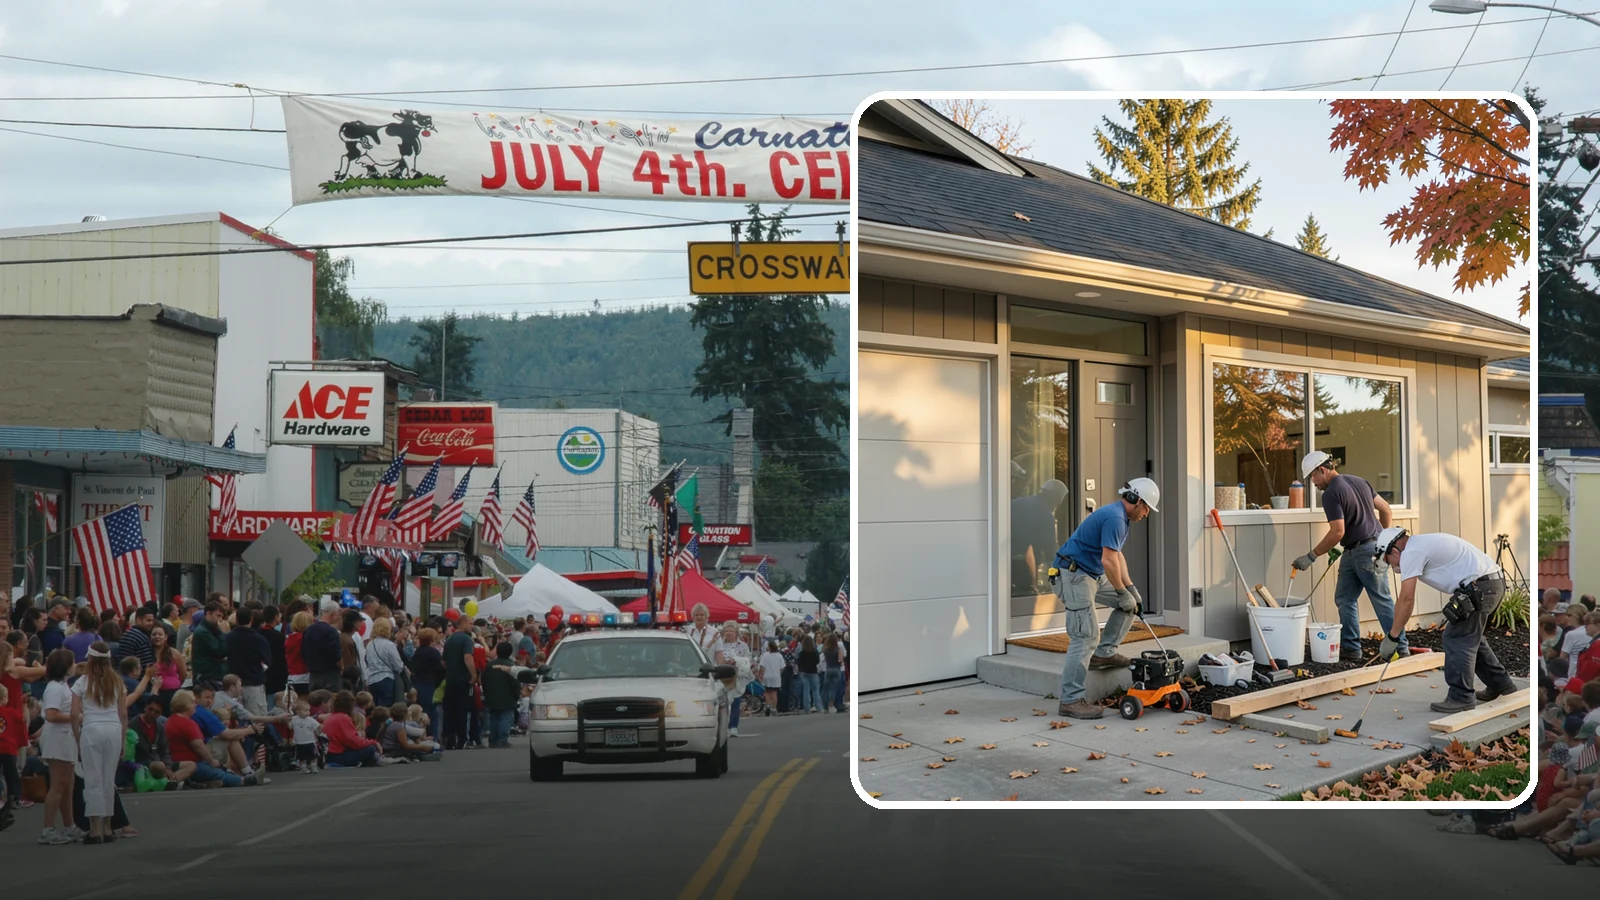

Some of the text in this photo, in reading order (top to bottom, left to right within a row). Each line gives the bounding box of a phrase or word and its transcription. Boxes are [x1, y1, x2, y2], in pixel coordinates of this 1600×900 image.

[481, 140, 605, 192] JULY
[632, 150, 746, 198] 4th.
[697, 254, 850, 280] CROSSWA
[283, 380, 374, 420] ACE
[405, 409, 452, 422] CEDAR
[283, 421, 371, 436] Hardware
[416, 428, 477, 447] Coca-Cola
[353, 467, 385, 480] Simpl
[95, 485, 124, 495] Vincent
[126, 486, 136, 495] de
[137, 486, 155, 495] Paul
[81, 503, 153, 522] THT
[688, 526, 741, 535] CRNATION
[699, 535, 730, 543] GLASS
